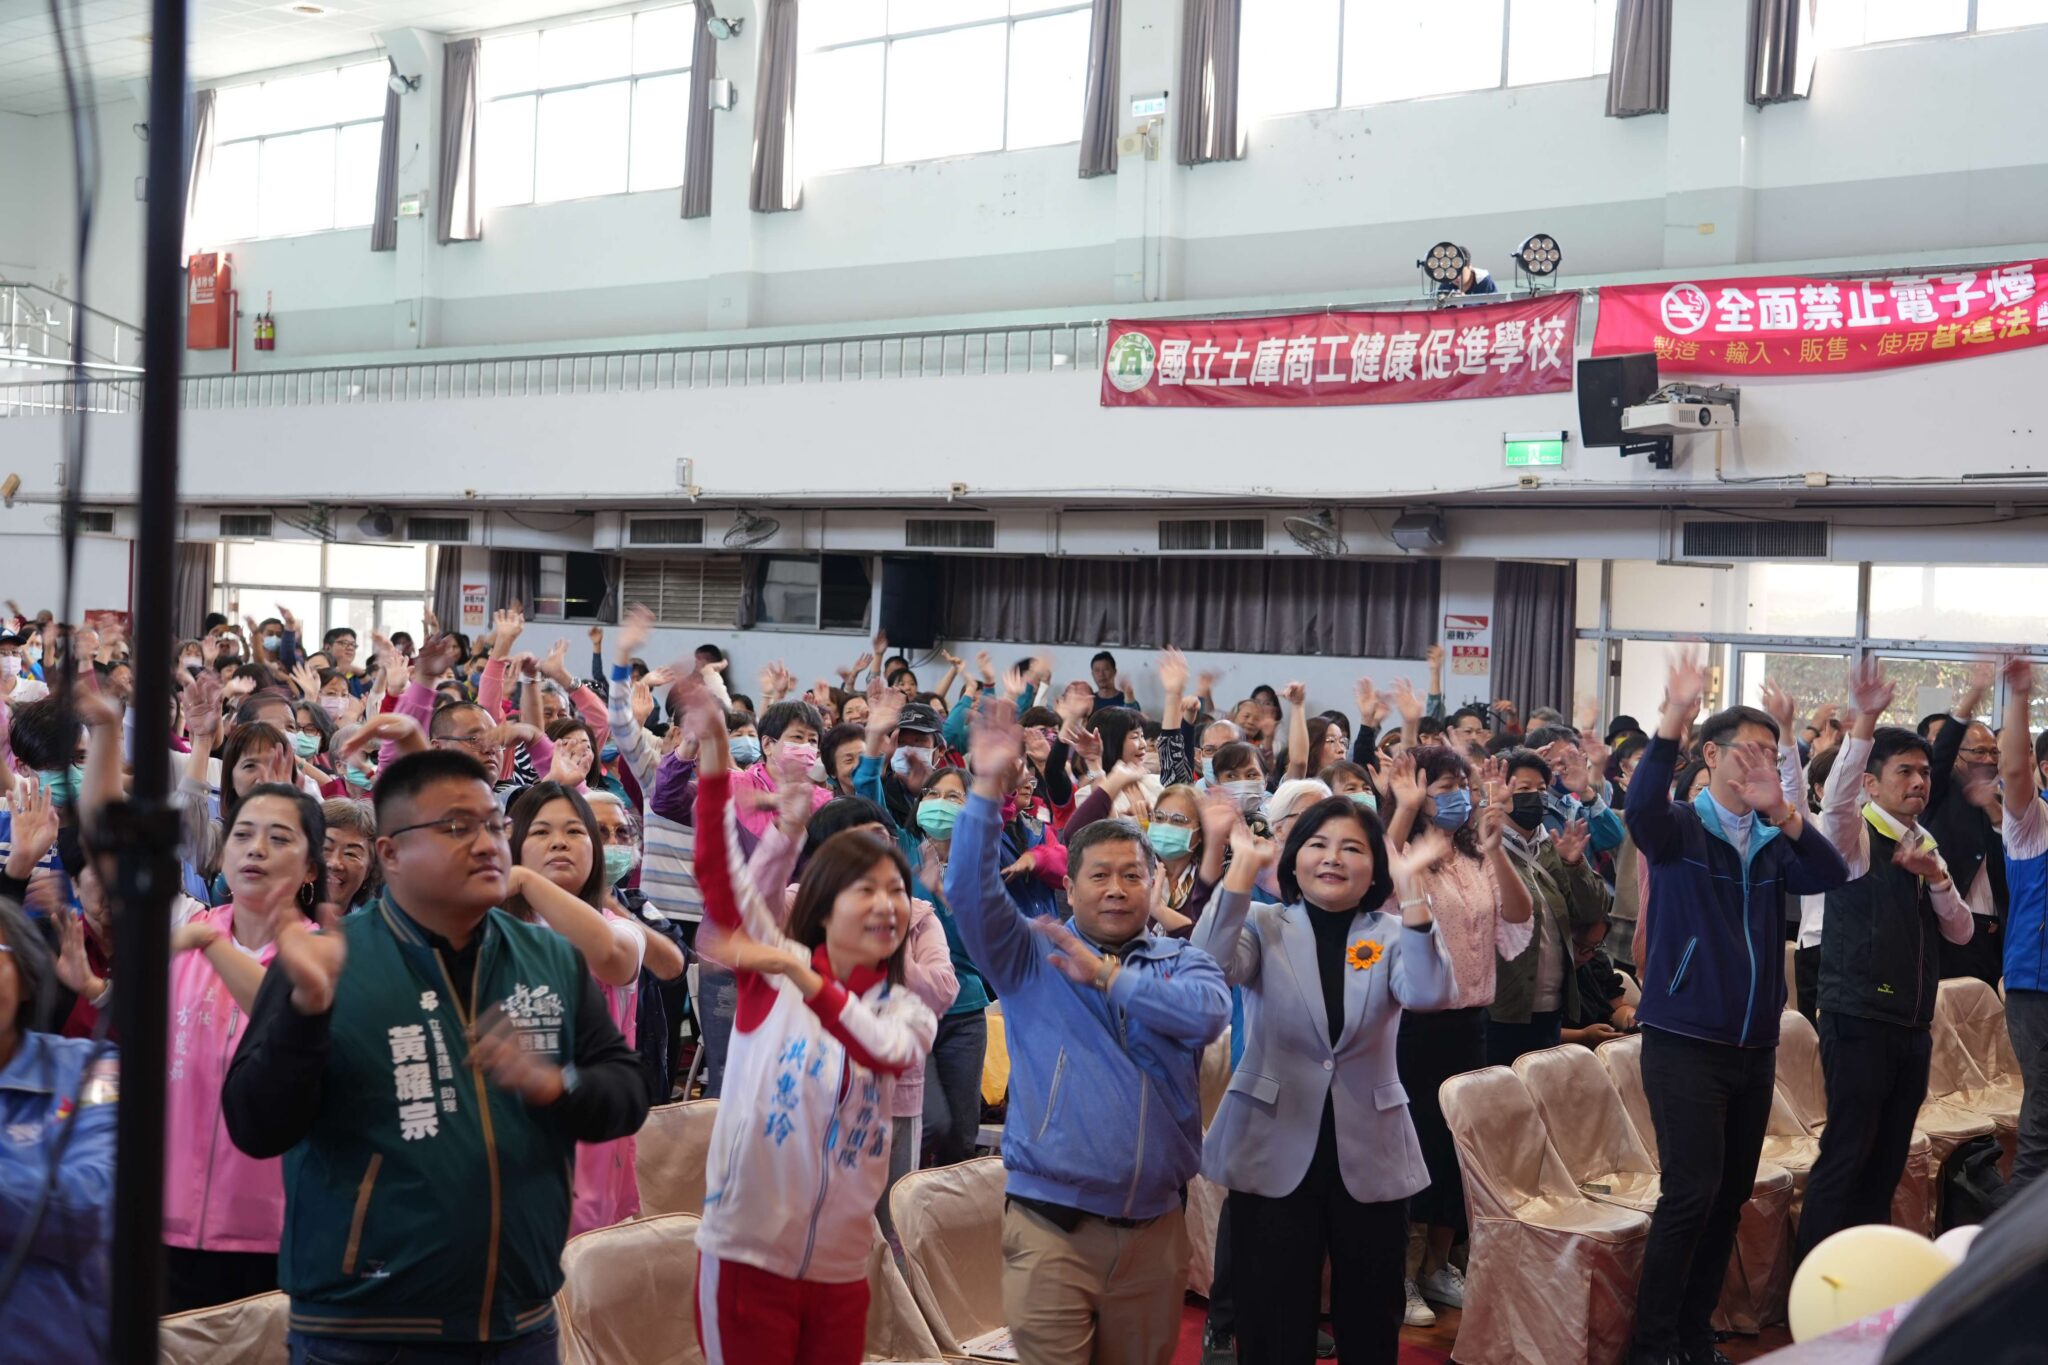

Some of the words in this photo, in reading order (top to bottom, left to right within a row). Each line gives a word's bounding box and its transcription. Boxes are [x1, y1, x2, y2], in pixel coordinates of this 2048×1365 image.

[1715, 264, 2036, 333] 全面禁止電子煙
[1157, 315, 1566, 387] 國立土庫商工健康促進學校
[388, 1024, 439, 1141] 黃耀宗
